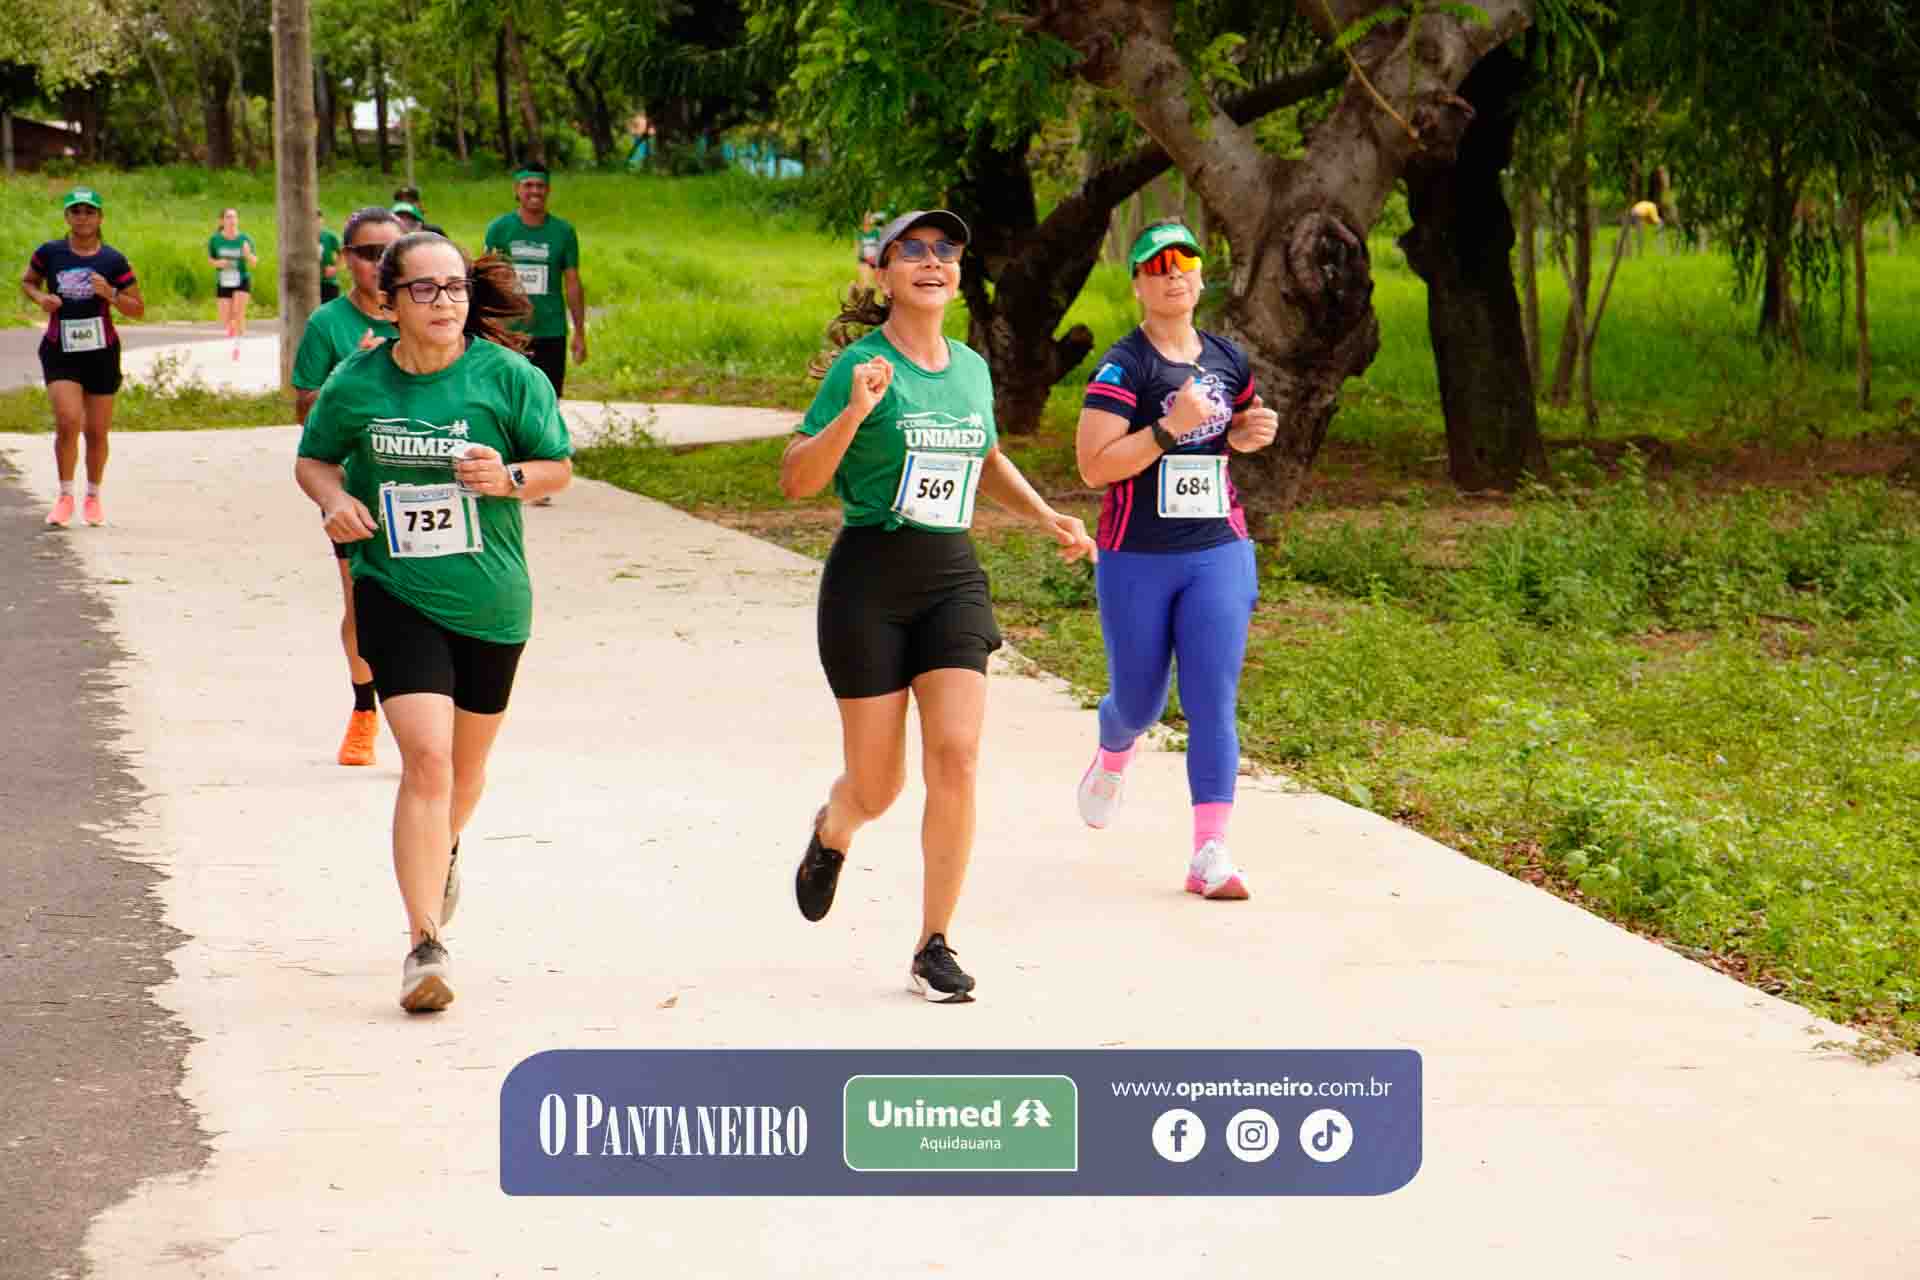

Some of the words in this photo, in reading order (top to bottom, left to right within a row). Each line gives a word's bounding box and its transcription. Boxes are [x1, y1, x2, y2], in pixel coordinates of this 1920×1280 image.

[904, 429, 987, 449] UNIMED
[917, 478, 954, 500] 569
[1175, 477, 1211, 496] 684
[404, 508, 453, 532] 732
